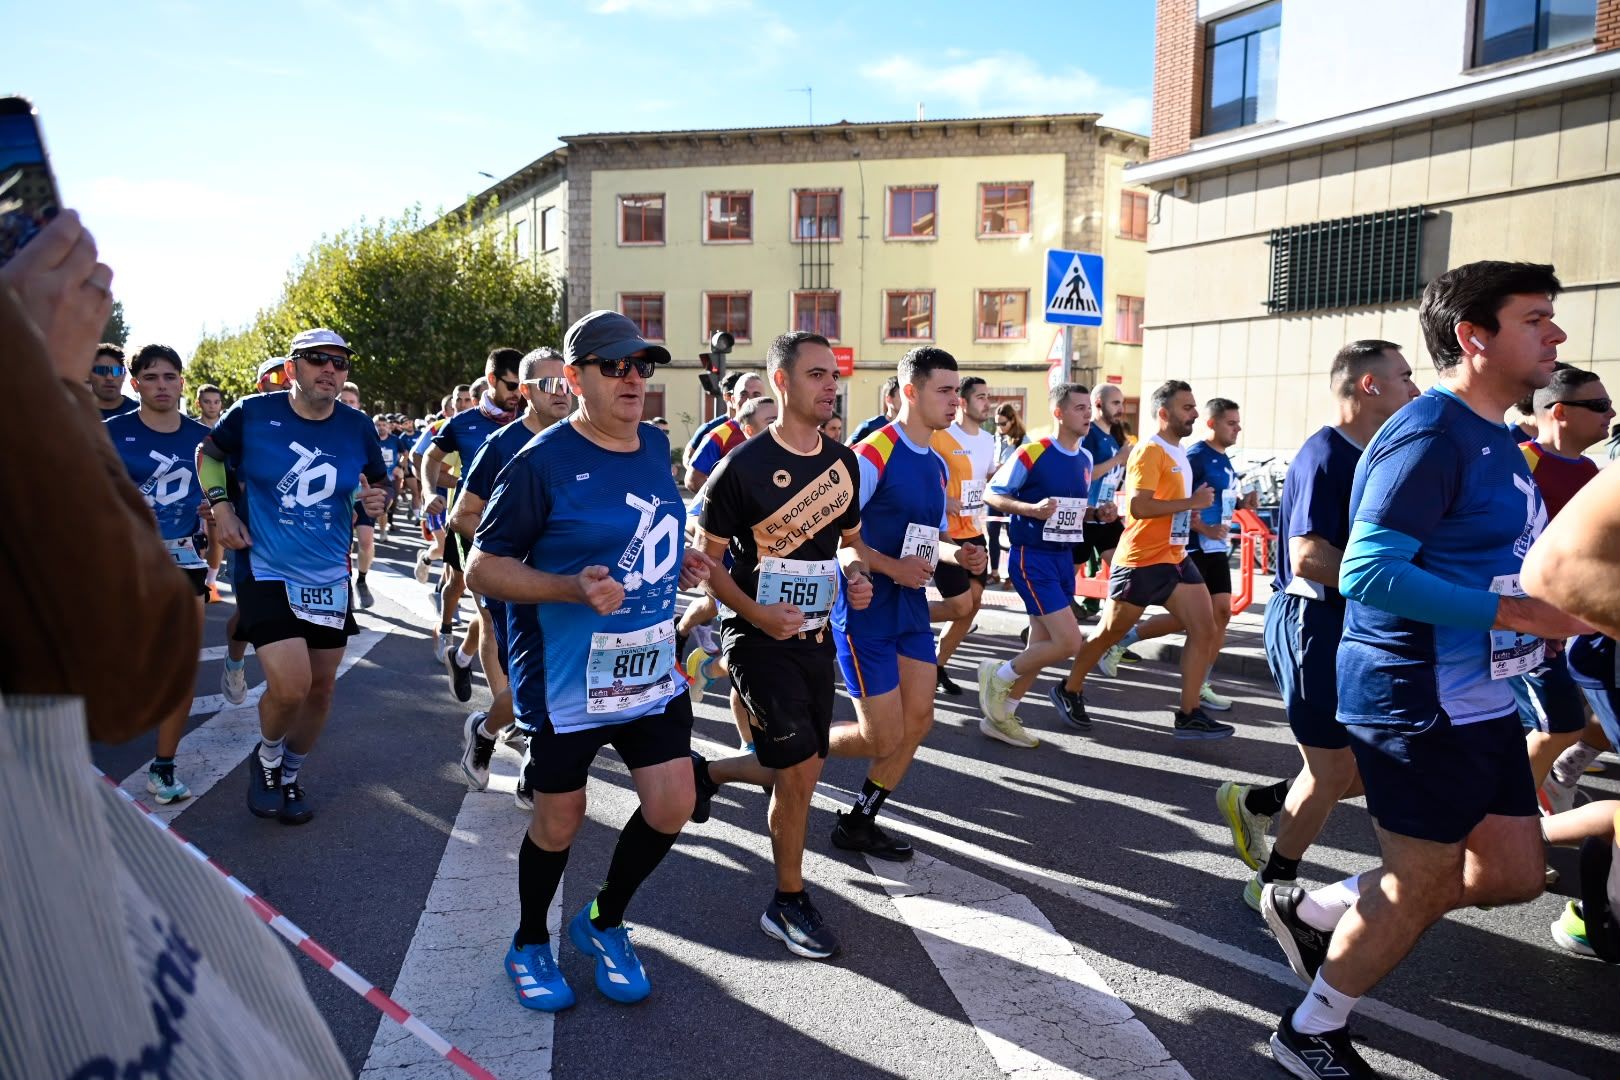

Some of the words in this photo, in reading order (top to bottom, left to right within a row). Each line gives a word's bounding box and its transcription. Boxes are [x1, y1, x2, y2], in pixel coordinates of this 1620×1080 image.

[766, 522, 782, 535] EL
[782, 480, 833, 524] BODEGÓN
[1057, 511, 1077, 526] 998
[301, 587, 334, 606] 693
[779, 581, 819, 606] 569
[613, 649, 660, 679] 807
